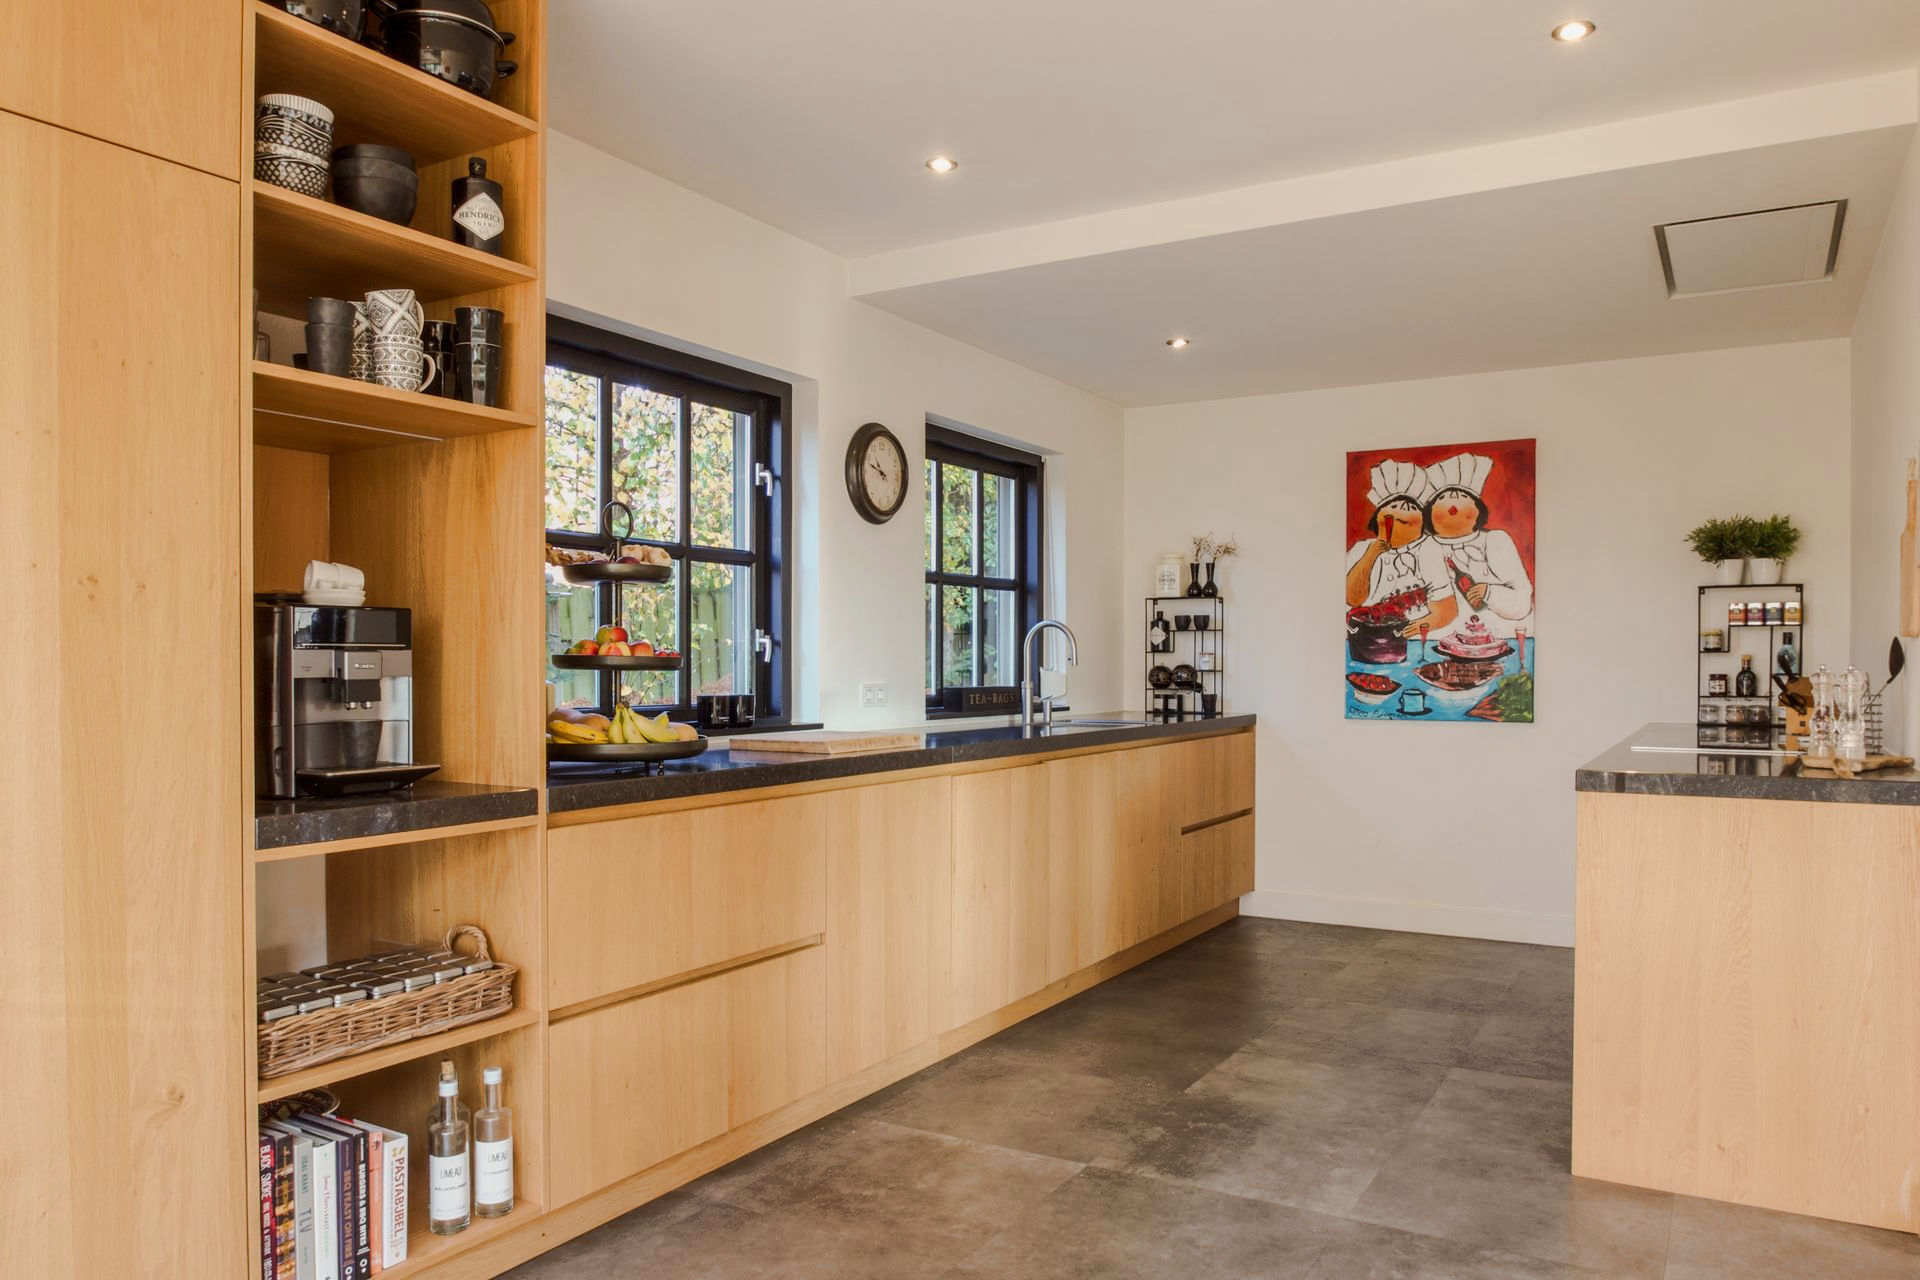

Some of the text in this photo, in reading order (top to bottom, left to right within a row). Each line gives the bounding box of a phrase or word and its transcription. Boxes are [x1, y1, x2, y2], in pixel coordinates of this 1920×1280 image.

[968, 692, 1015, 705] TEA-BAGS
[260, 1144, 271, 1171] BLACK
[261, 1172, 272, 1200] SMOKE
[359, 1163, 367, 1199] BURGERS
[344, 1192, 352, 1220] FEAST
[344, 1222, 352, 1239] ON
[344, 1239, 353, 1259] FIRE
